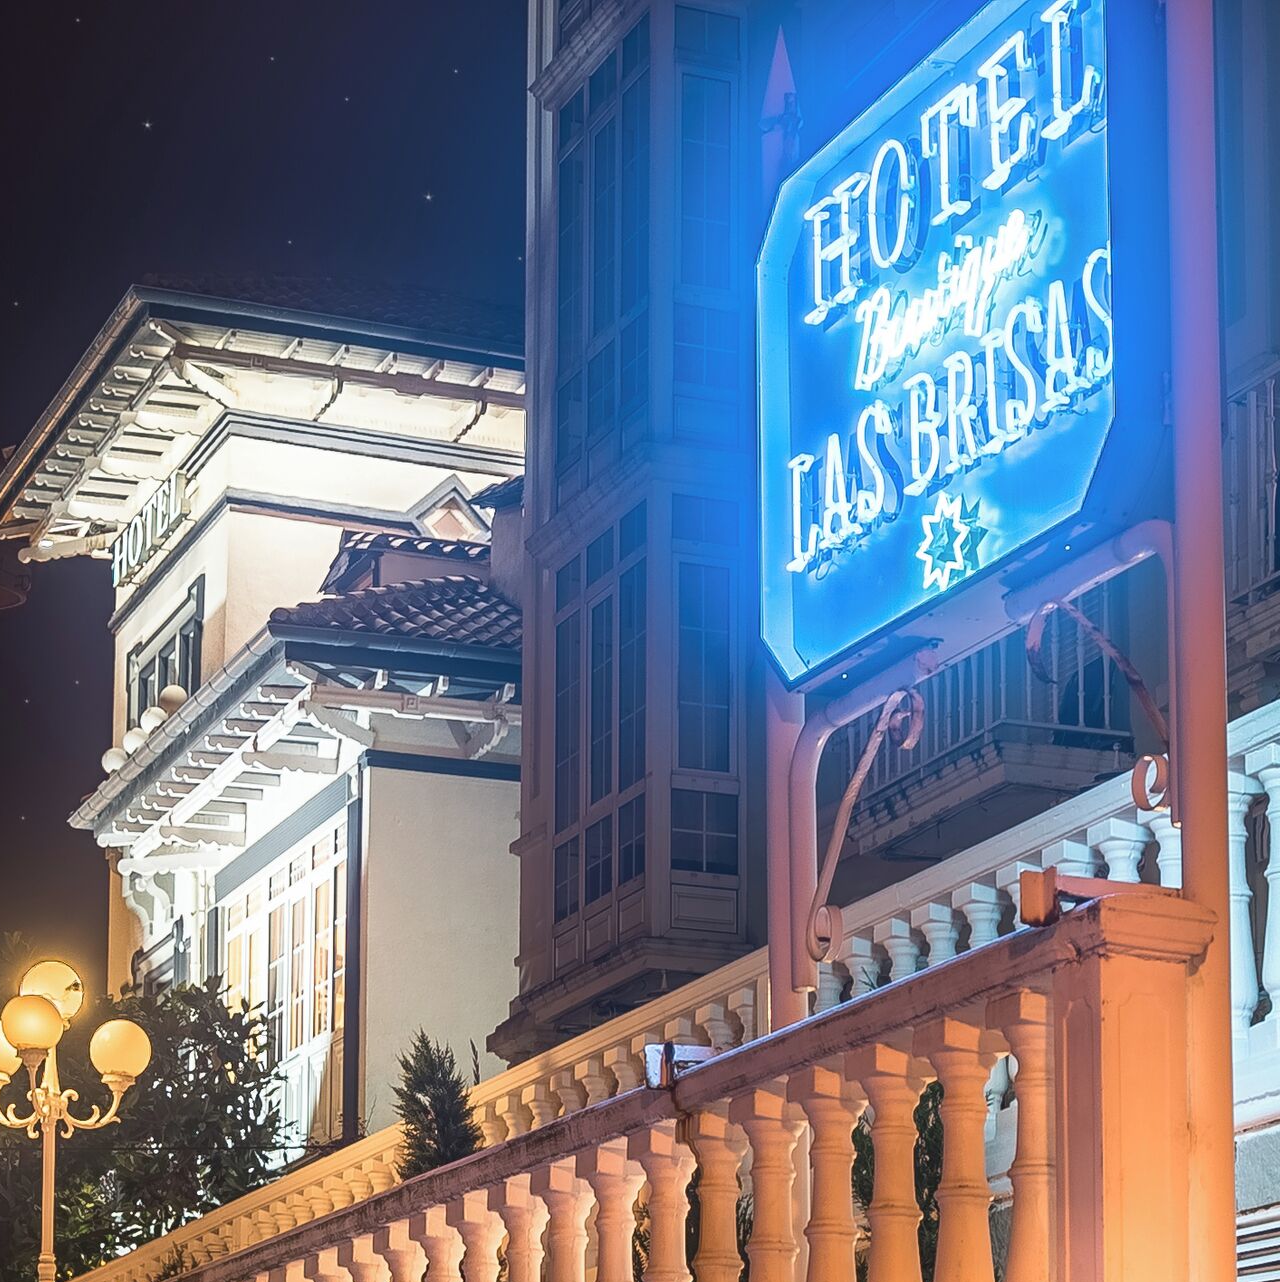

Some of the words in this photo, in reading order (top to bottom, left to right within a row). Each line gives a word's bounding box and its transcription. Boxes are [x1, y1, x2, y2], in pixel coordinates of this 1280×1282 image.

[804, 0, 1098, 325] HOTEL
[111, 470, 184, 588] HOTEL
[786, 399, 892, 572] LAS
[903, 242, 1113, 496] BRISAS
